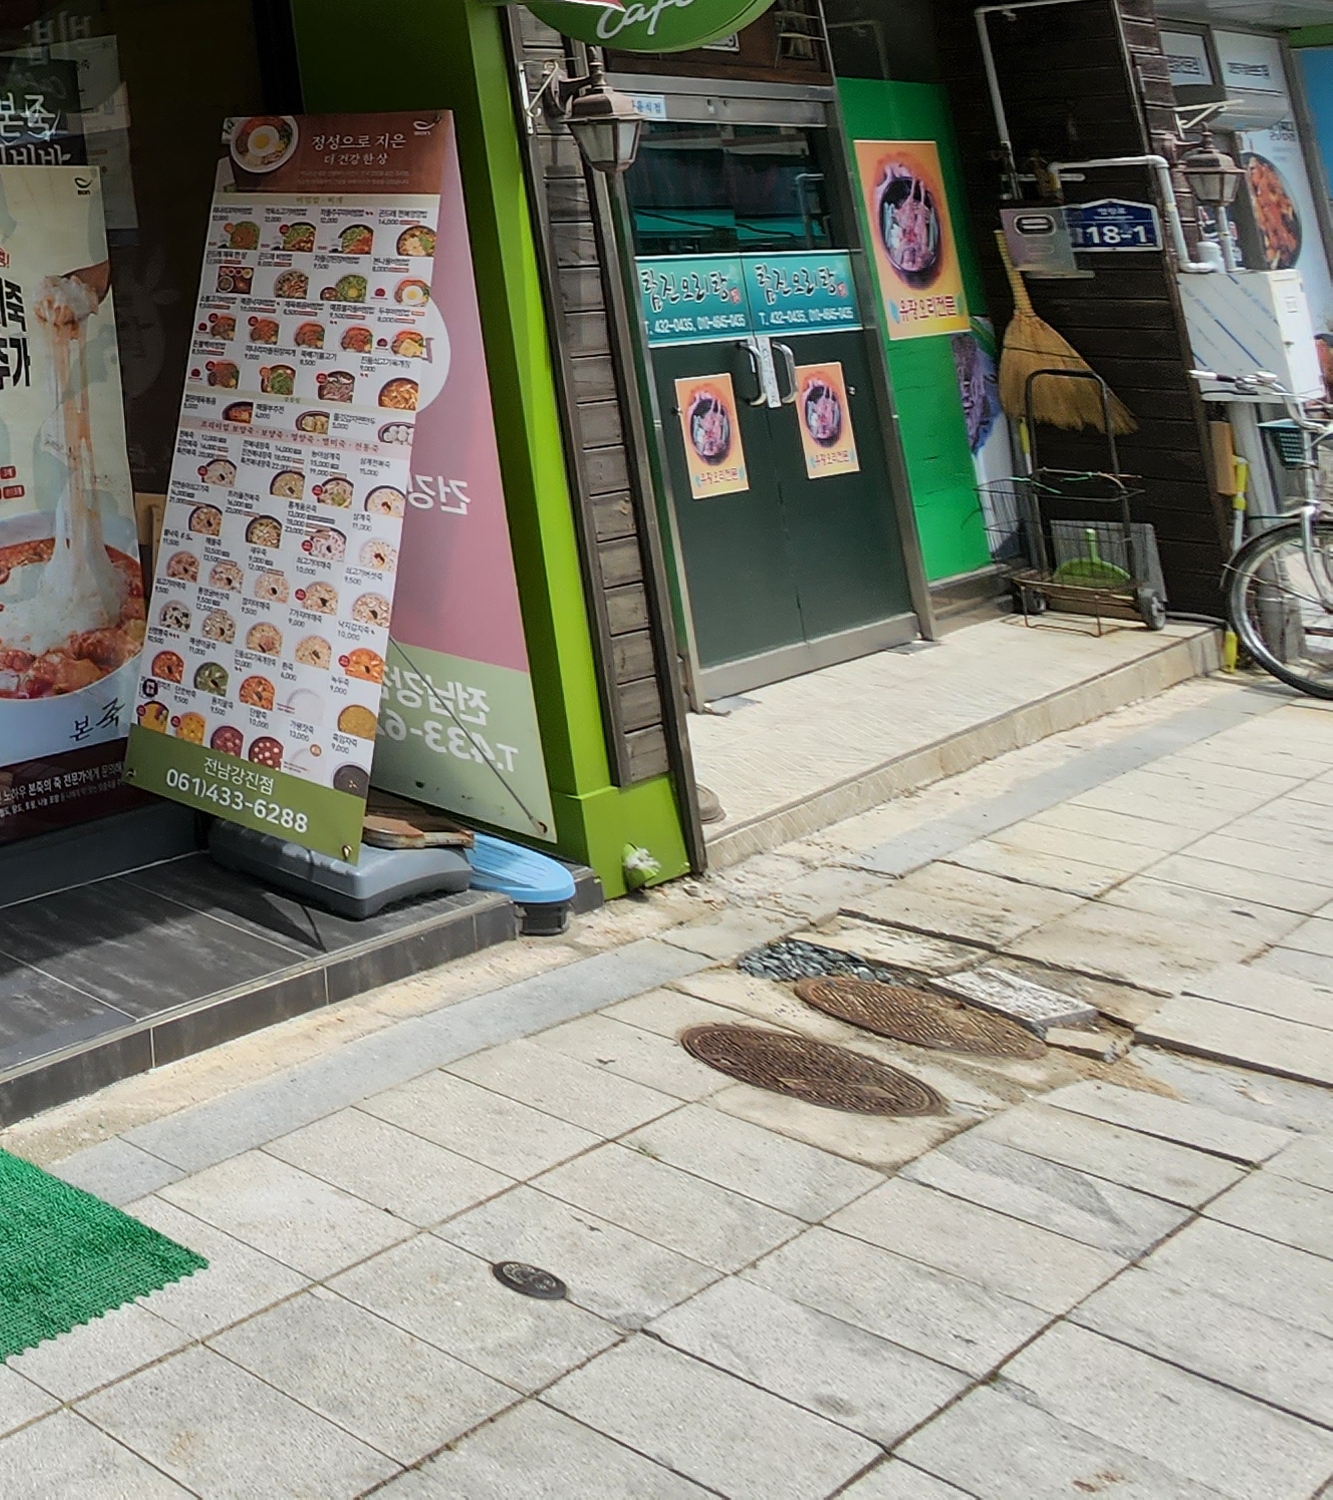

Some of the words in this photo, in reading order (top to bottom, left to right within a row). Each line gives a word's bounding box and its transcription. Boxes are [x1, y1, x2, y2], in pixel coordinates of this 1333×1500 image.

[311, 134, 371, 151] 정성으로
[375, 133, 407, 149] 지은
[1086, 225, 1147, 244] 18-1
[69, 697, 126, 742] 본죽
[28, 778, 52, 797] 본죽의
[203, 757, 274, 796] 전남강진점
[165, 768, 309, 834] 061)433-6288
